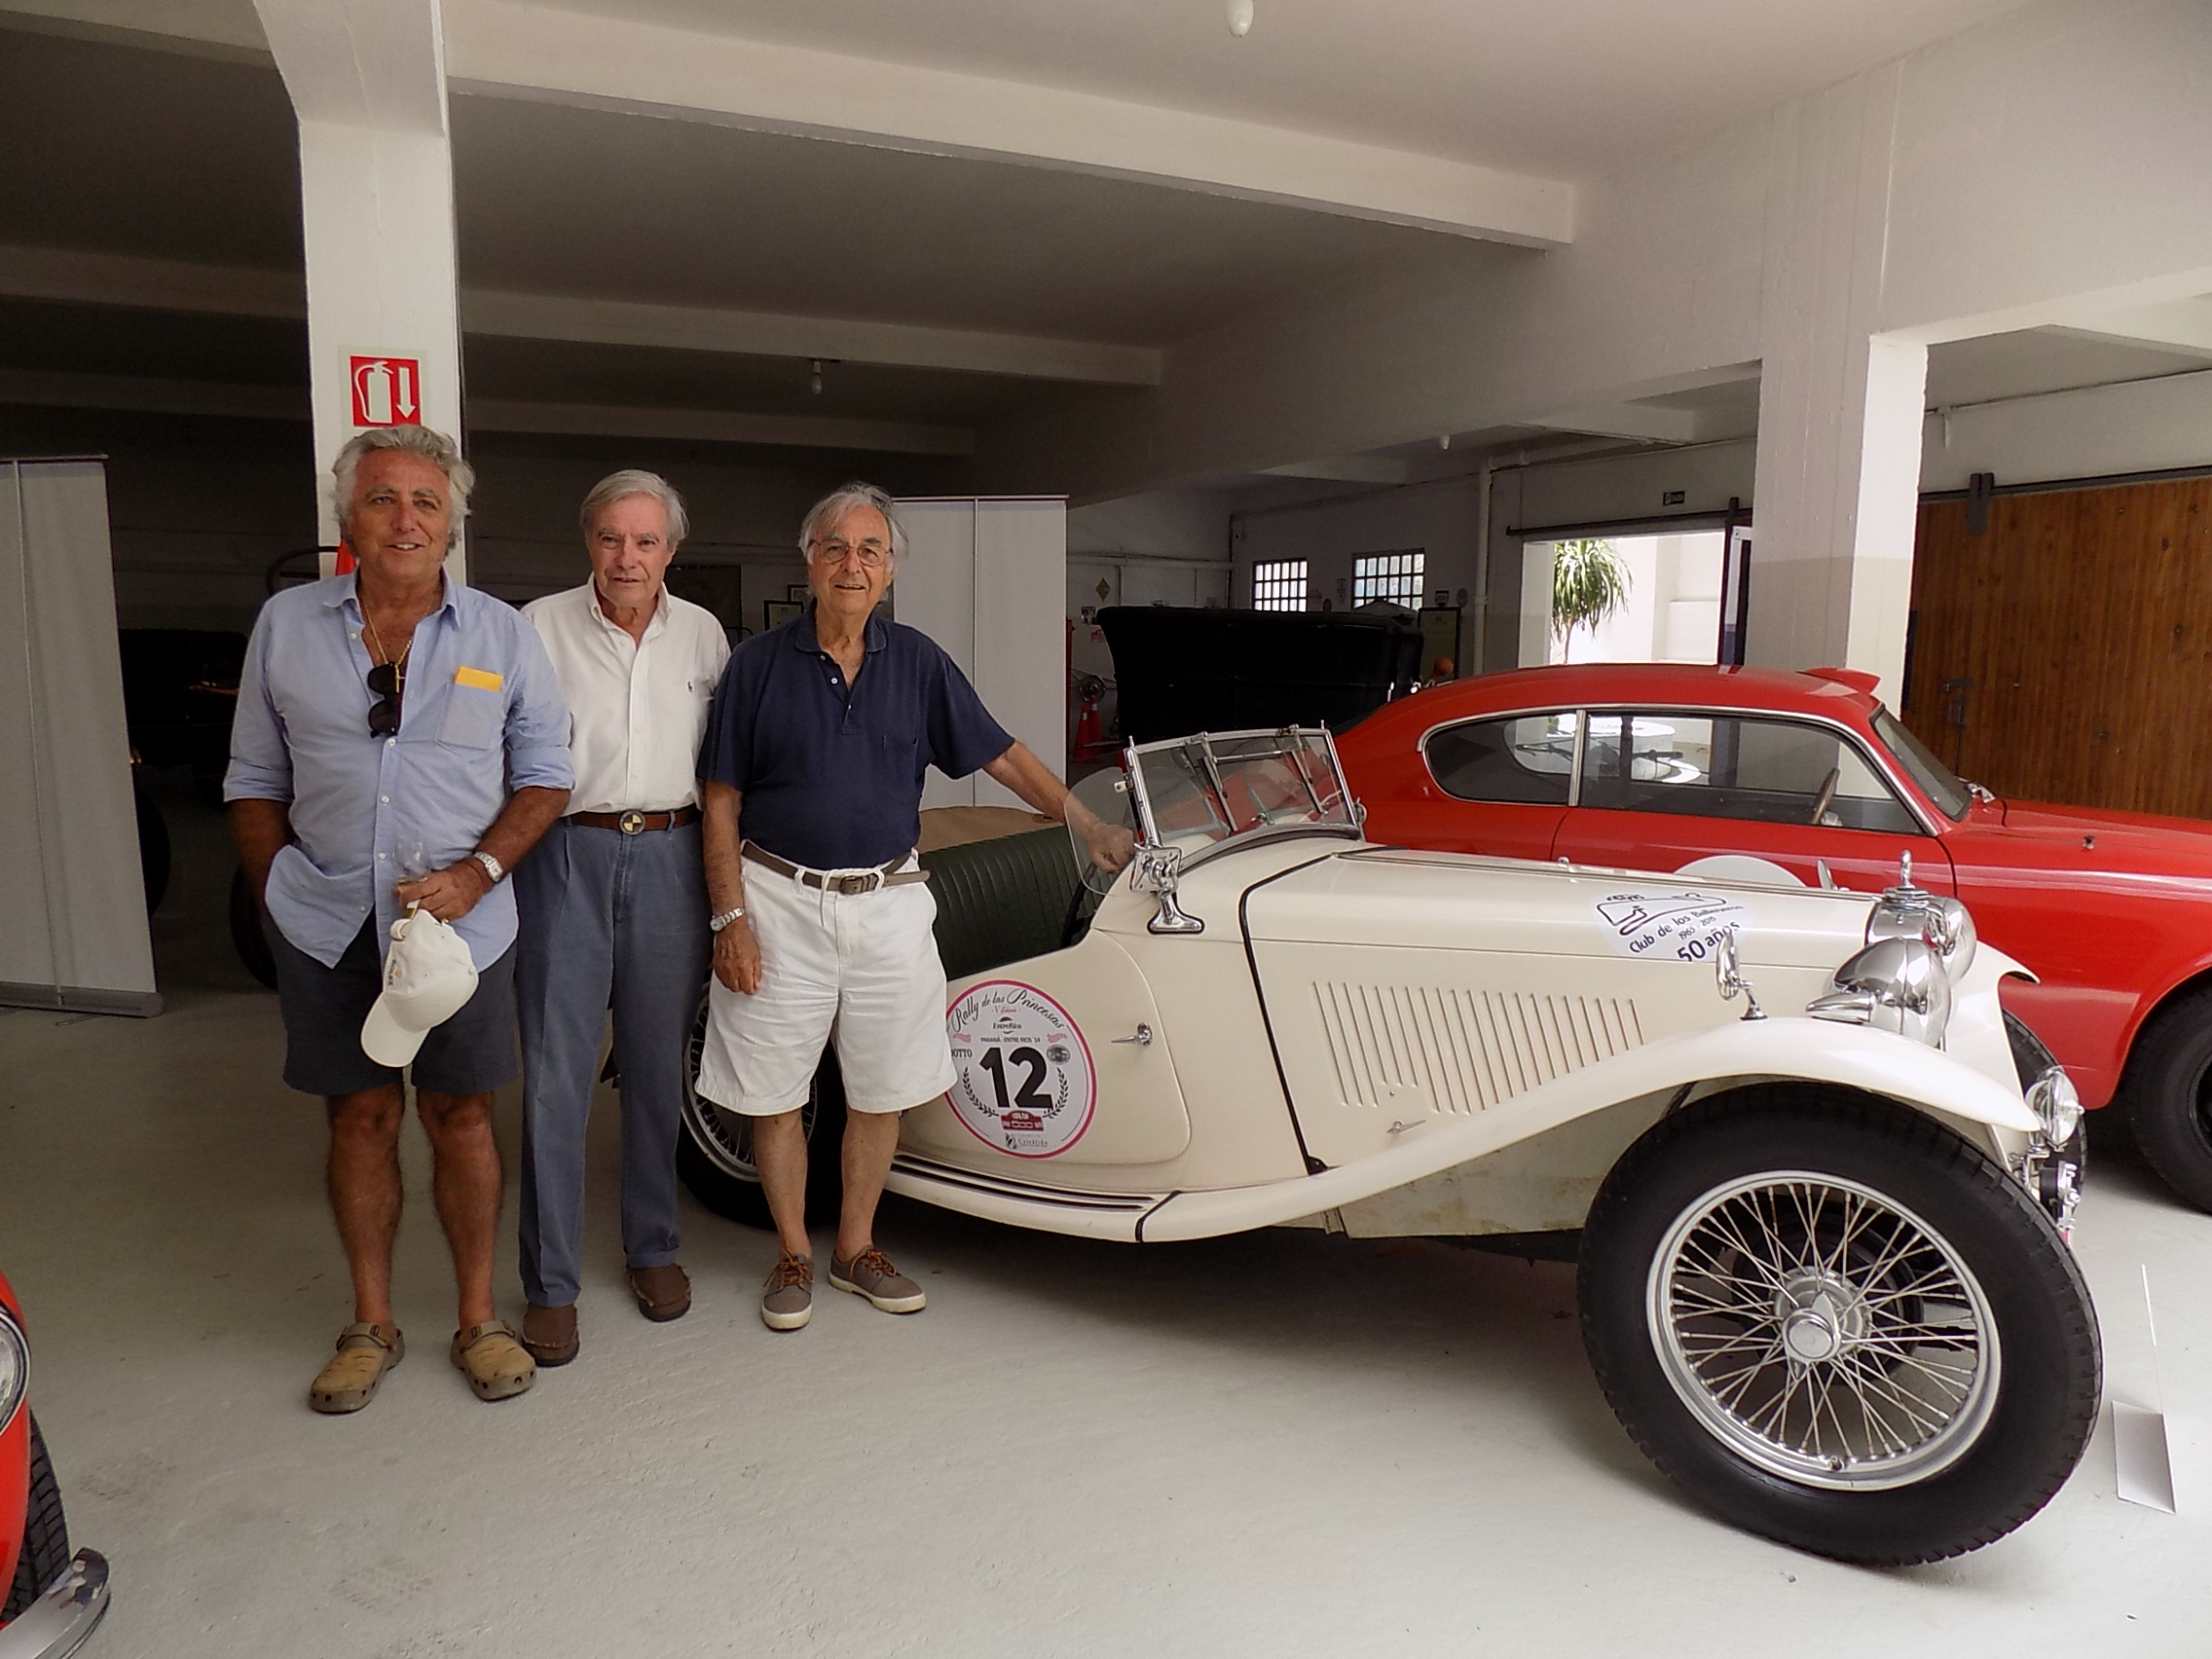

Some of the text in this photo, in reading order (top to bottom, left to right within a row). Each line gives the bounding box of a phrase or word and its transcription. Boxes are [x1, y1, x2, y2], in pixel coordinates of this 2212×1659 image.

[1630, 915, 1691, 953] Club de los
[1677, 921, 1741, 962] 50 años
[1678, 927, 1696, 940] 1965
[951, 988, 1065, 1032] Rally de las Princesas
[979, 1047, 1053, 1110] 12
